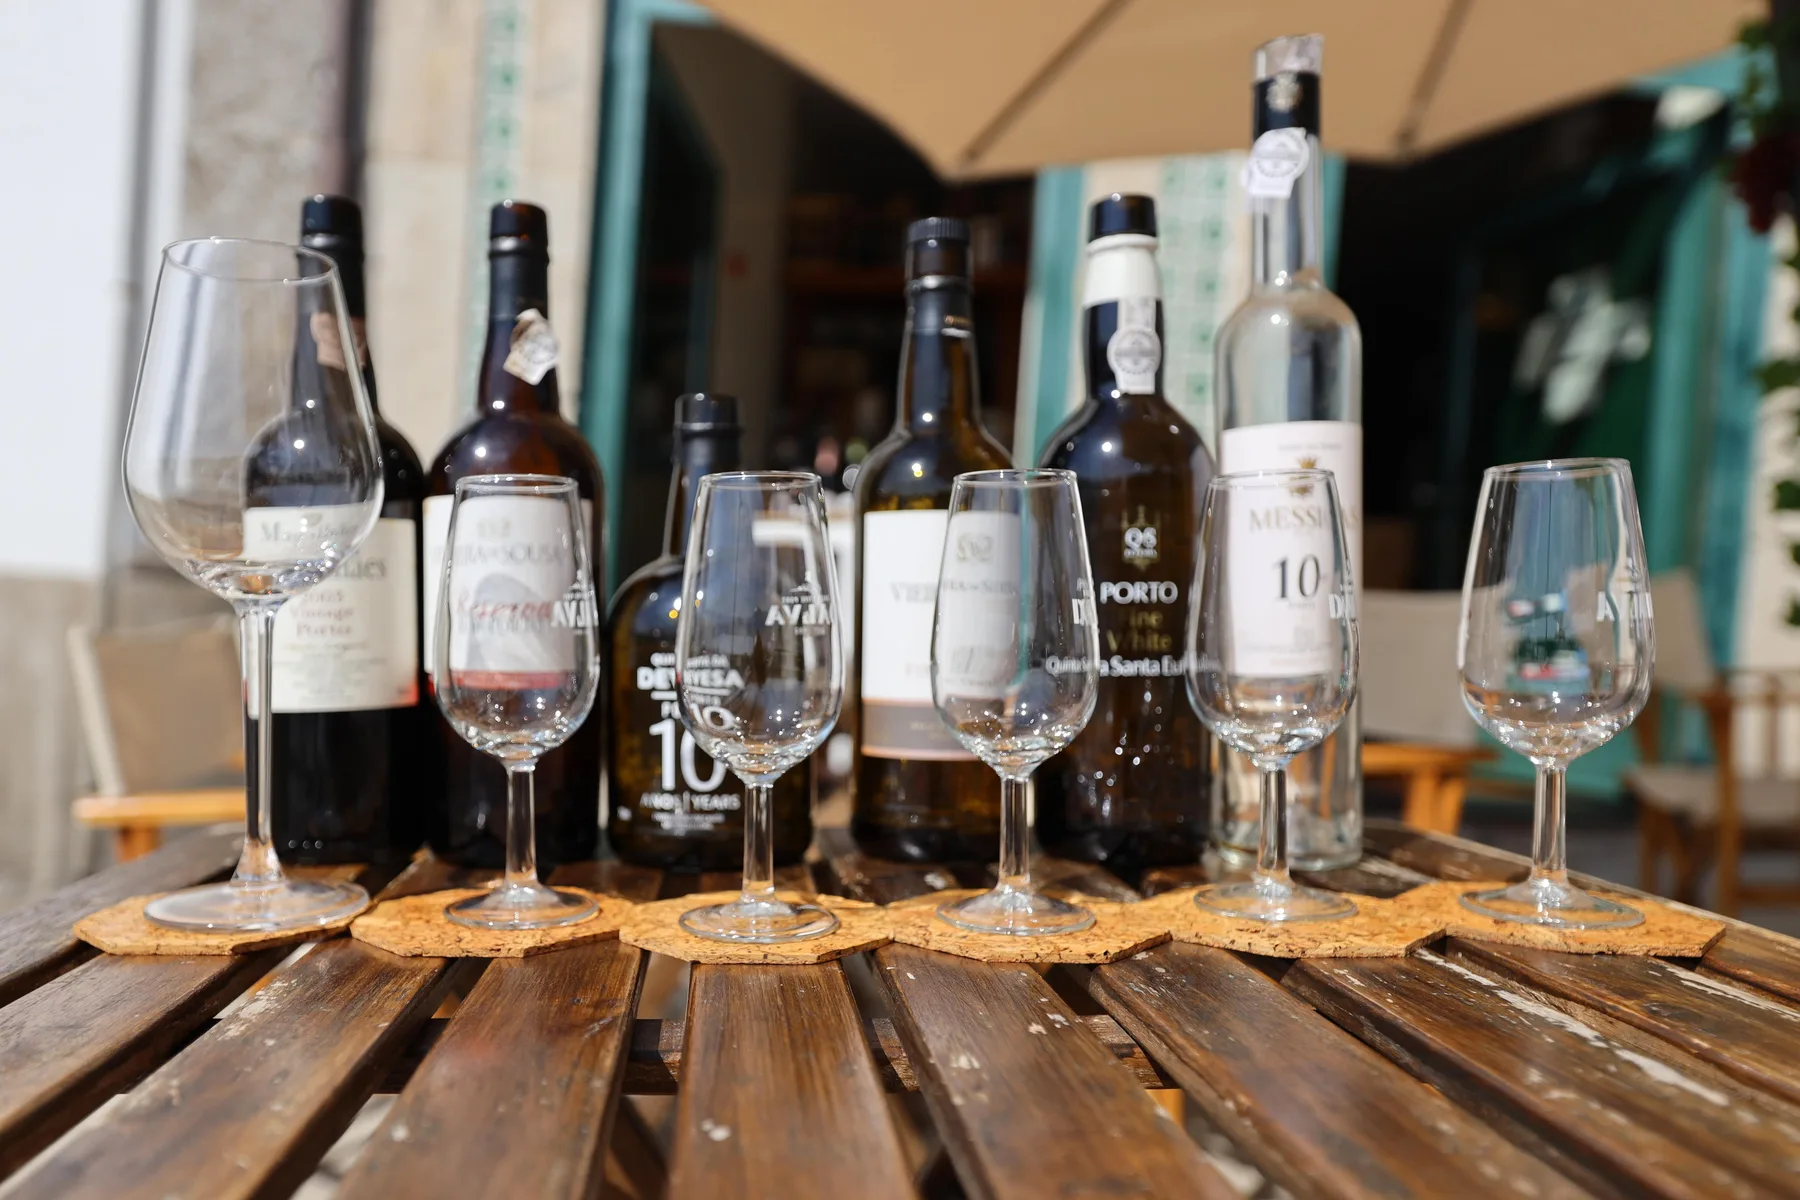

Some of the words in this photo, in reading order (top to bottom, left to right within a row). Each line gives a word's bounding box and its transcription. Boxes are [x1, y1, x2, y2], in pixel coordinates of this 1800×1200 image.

[1100, 581, 1178, 604] PORTO
[1273, 554, 1321, 601] 10
[1109, 655, 1160, 677] Santa
[649, 718, 728, 792] 10
